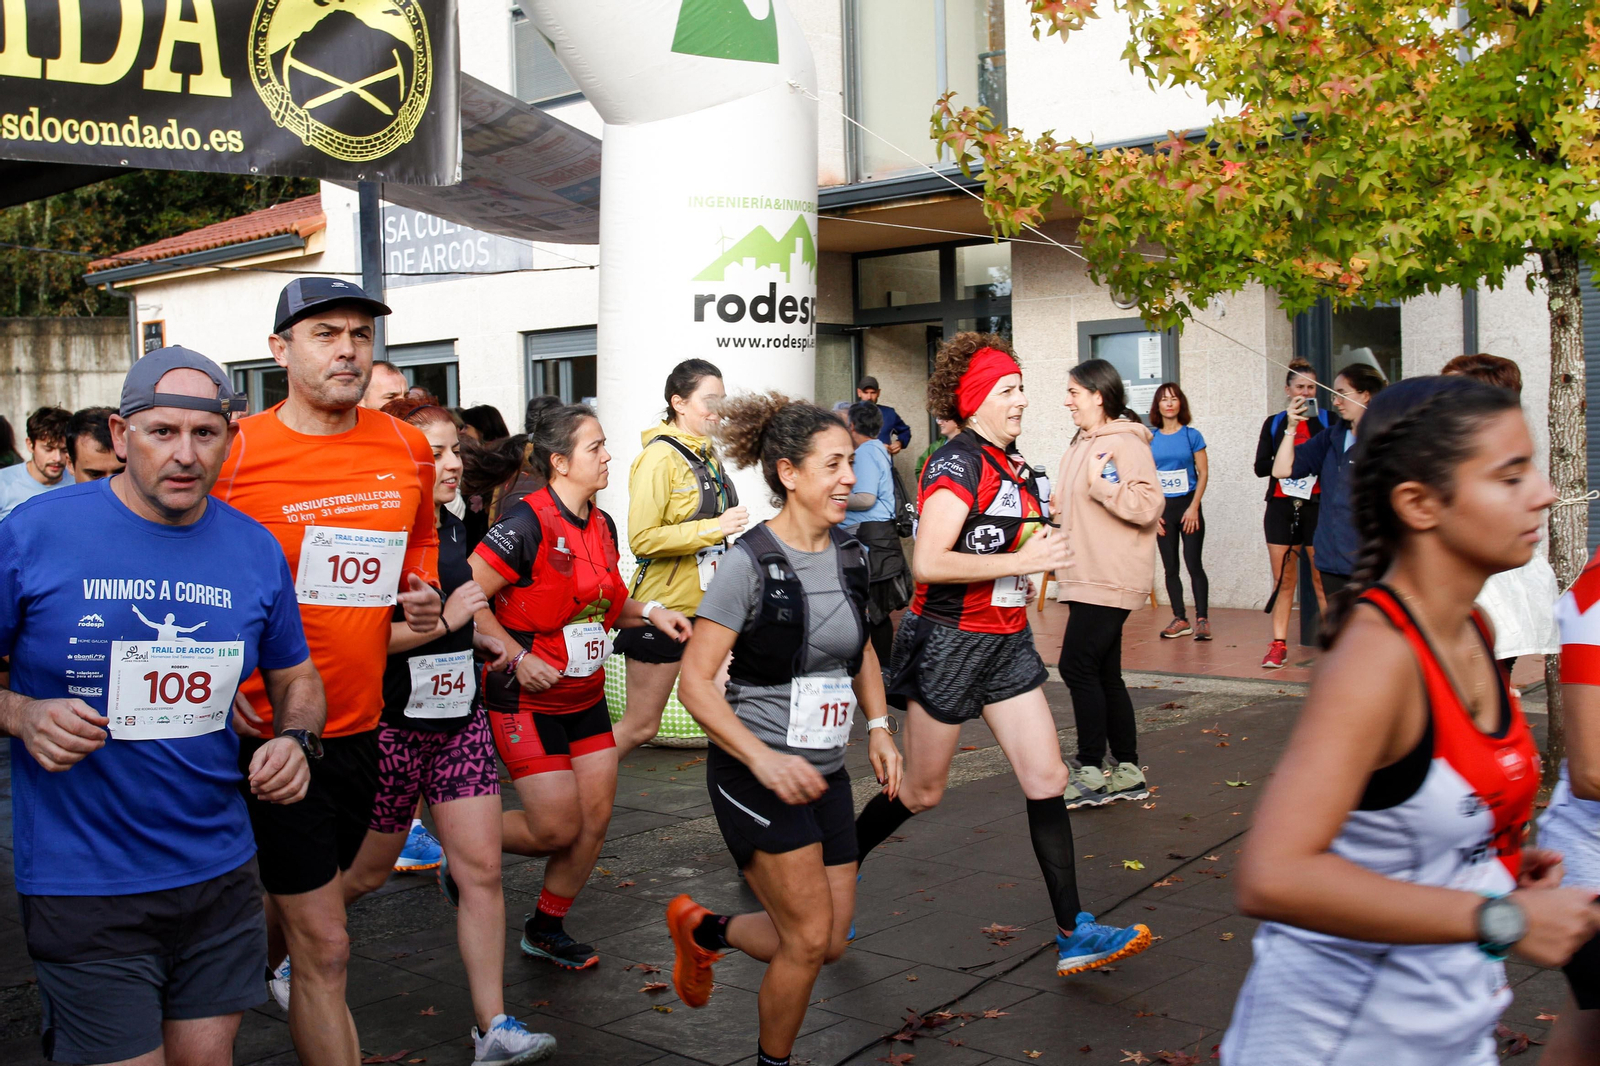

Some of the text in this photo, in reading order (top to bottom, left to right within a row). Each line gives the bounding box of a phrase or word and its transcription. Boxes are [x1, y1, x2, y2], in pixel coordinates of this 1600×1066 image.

[0, 107, 245, 153] sdocondado.es
[390, 236, 490, 278] DE ARCOS
[1161, 478, 1182, 488] 549
[1284, 478, 1307, 490] 542
[281, 490, 402, 515] SANSILVESTREVALLECANA
[286, 500, 401, 523] 10 km 31 diciembre 2007
[328, 555, 381, 585] 109
[83, 579, 232, 609] VINIMOS A CORRER
[78, 621, 105, 629] rodespi
[151, 646, 174, 654] TRAIL
[175, 646, 187, 654] DE
[218, 648, 226, 657] 11
[227, 647, 239, 656] km
[584, 640, 605, 660] 151
[143, 671, 212, 705] 108
[431, 671, 466, 696] 154
[820, 702, 850, 727] 113
